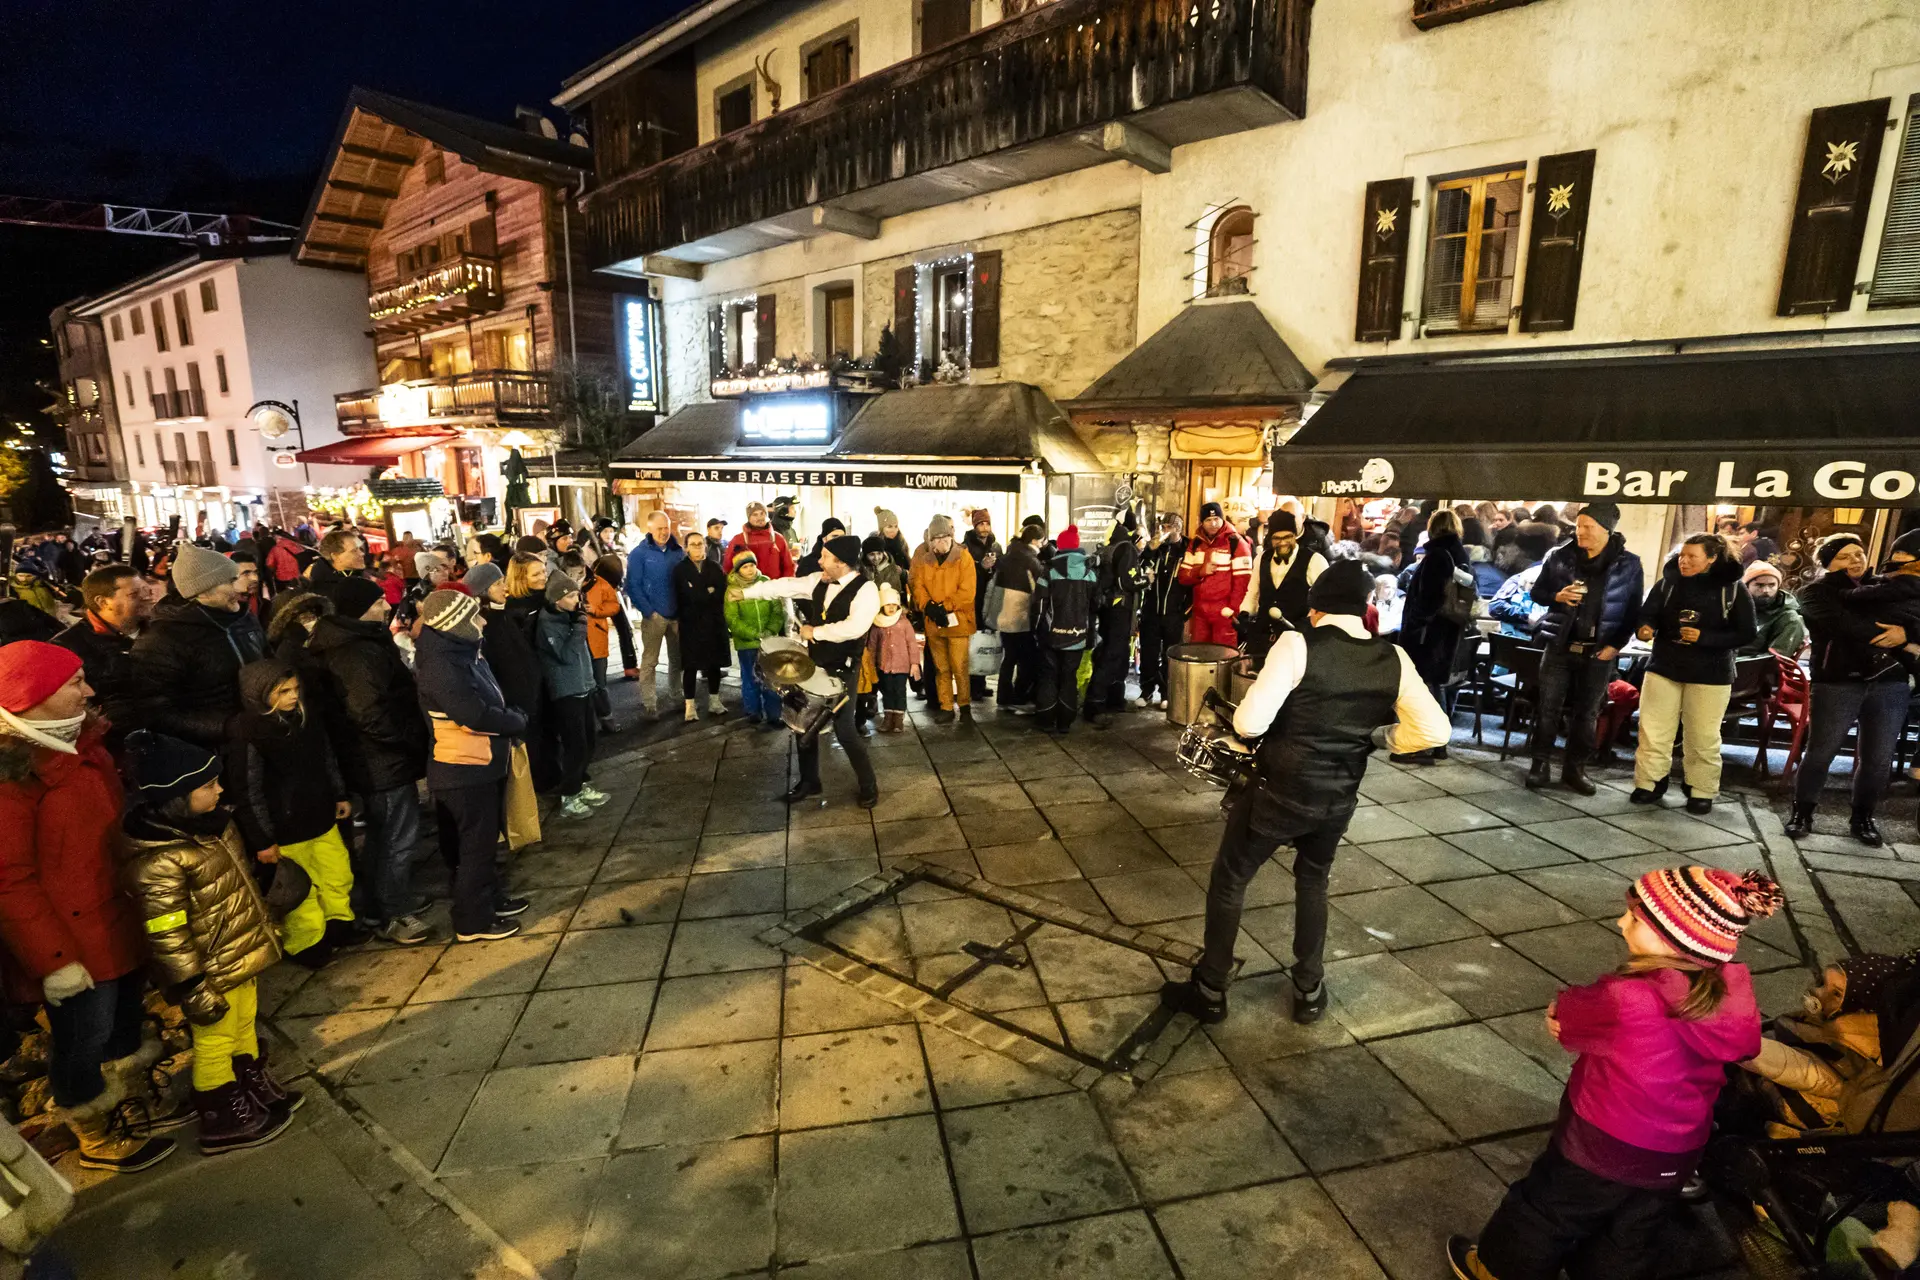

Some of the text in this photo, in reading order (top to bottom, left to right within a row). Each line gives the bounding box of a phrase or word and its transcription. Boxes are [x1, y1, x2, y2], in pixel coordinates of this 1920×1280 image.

[687, 470, 719, 481] BAR
[738, 472, 863, 485] BRASSERIE
[1583, 460, 1920, 500] Bar La Go
